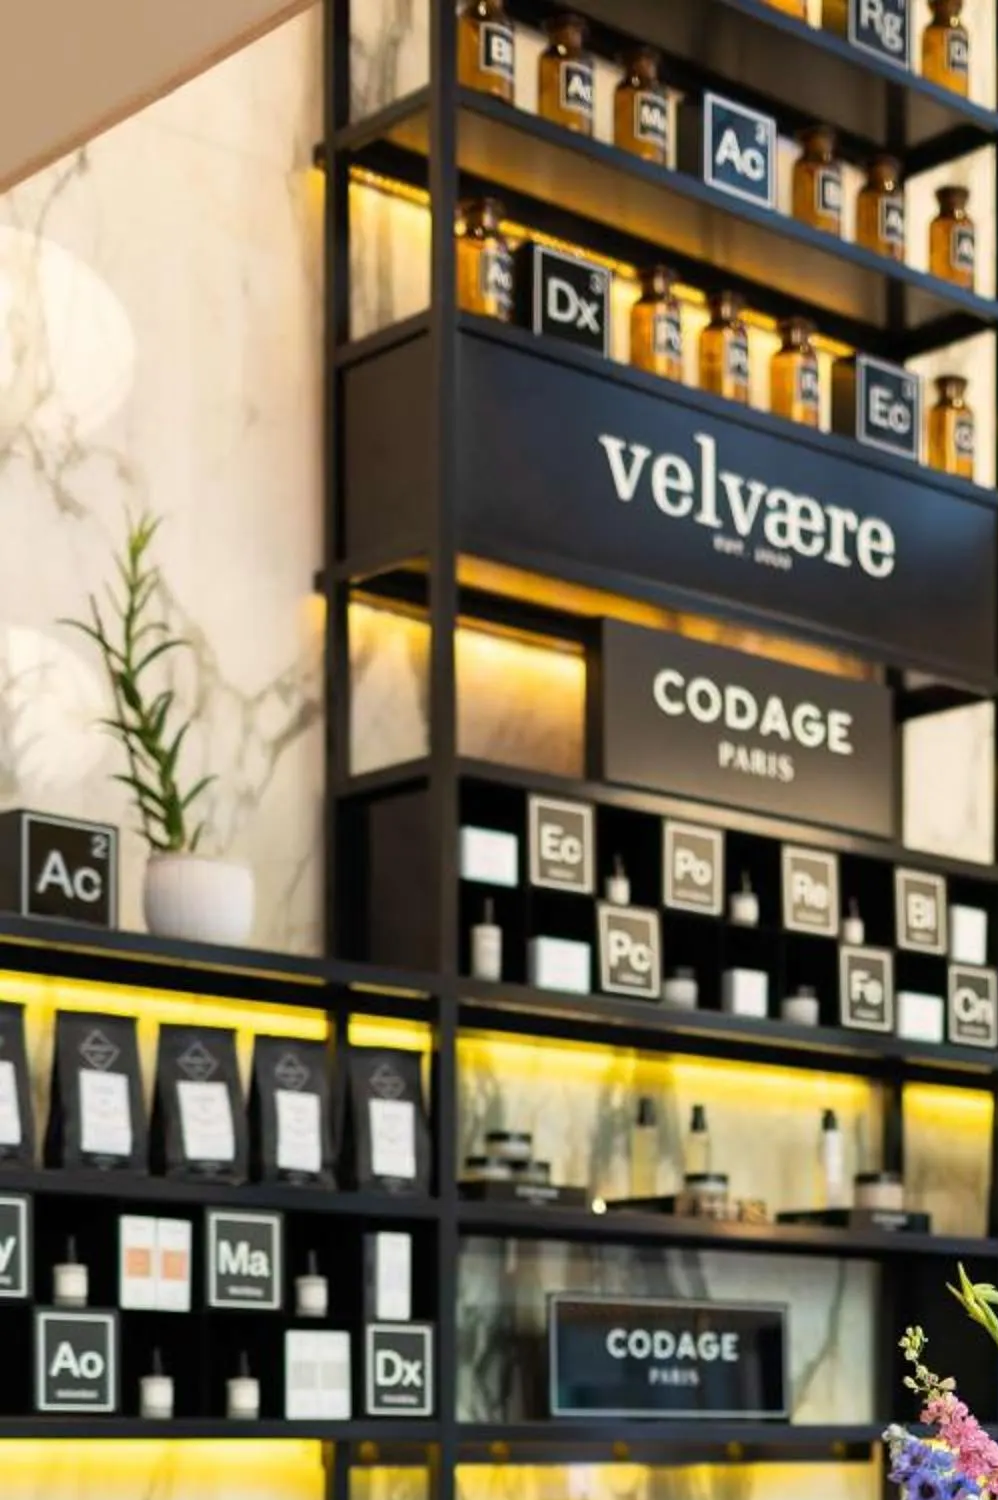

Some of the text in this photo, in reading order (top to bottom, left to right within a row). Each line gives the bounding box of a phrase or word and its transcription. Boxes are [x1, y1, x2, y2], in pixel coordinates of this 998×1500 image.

[859, 0, 904, 53] Rg
[715, 128, 765, 182] Ac
[547, 276, 600, 334] Dx
[598, 432, 896, 579] velvære
[653, 668, 854, 755] CODAGE
[717, 740, 795, 783] PARIS
[91, 834, 107, 859] 2
[36, 848, 102, 903] Ac
[217, 1240, 271, 1278] Ma
[48, 1340, 105, 1379] Ao
[374, 1349, 423, 1388] Dx
[605, 1327, 740, 1362] CODAGE
